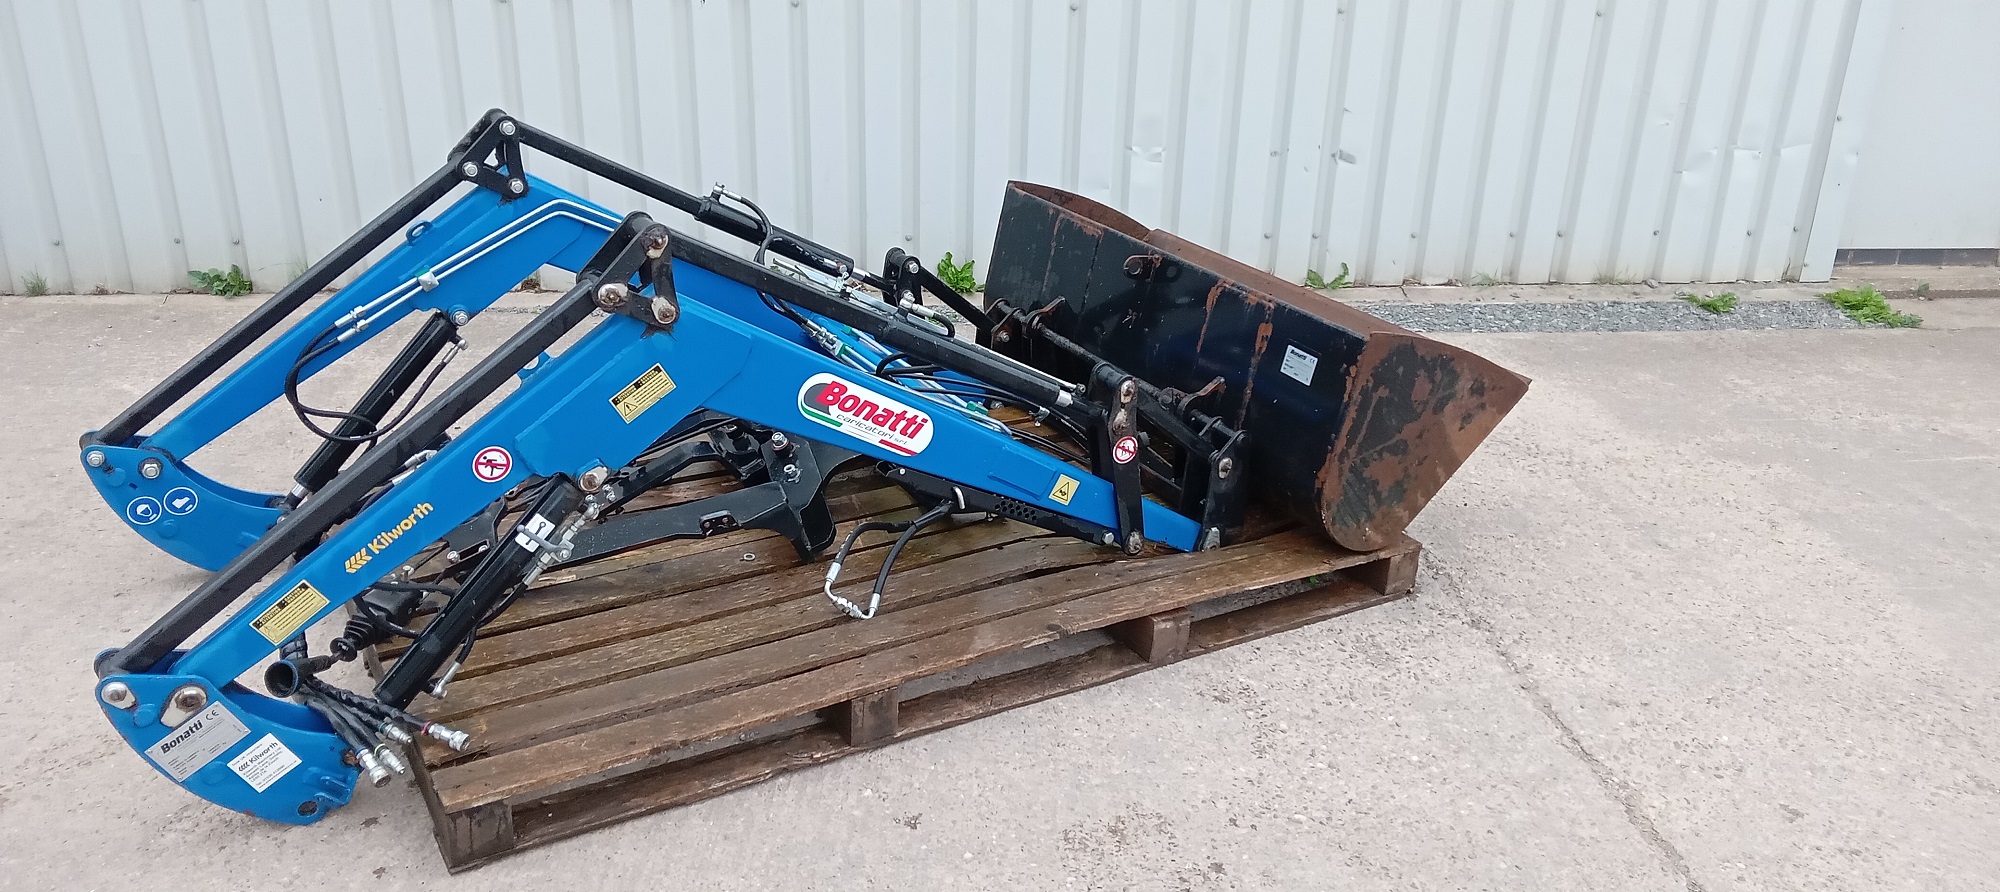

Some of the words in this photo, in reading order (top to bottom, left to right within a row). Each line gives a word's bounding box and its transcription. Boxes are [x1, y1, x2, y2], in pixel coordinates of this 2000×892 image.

[816, 381, 928, 439] Bonatti
[836, 413, 894, 440] caricatori
[368, 502, 433, 553] Kilworth
[205, 709, 219, 721] CE
[160, 719, 203, 754] Bonatti
[249, 741, 278, 764] Kilworth
